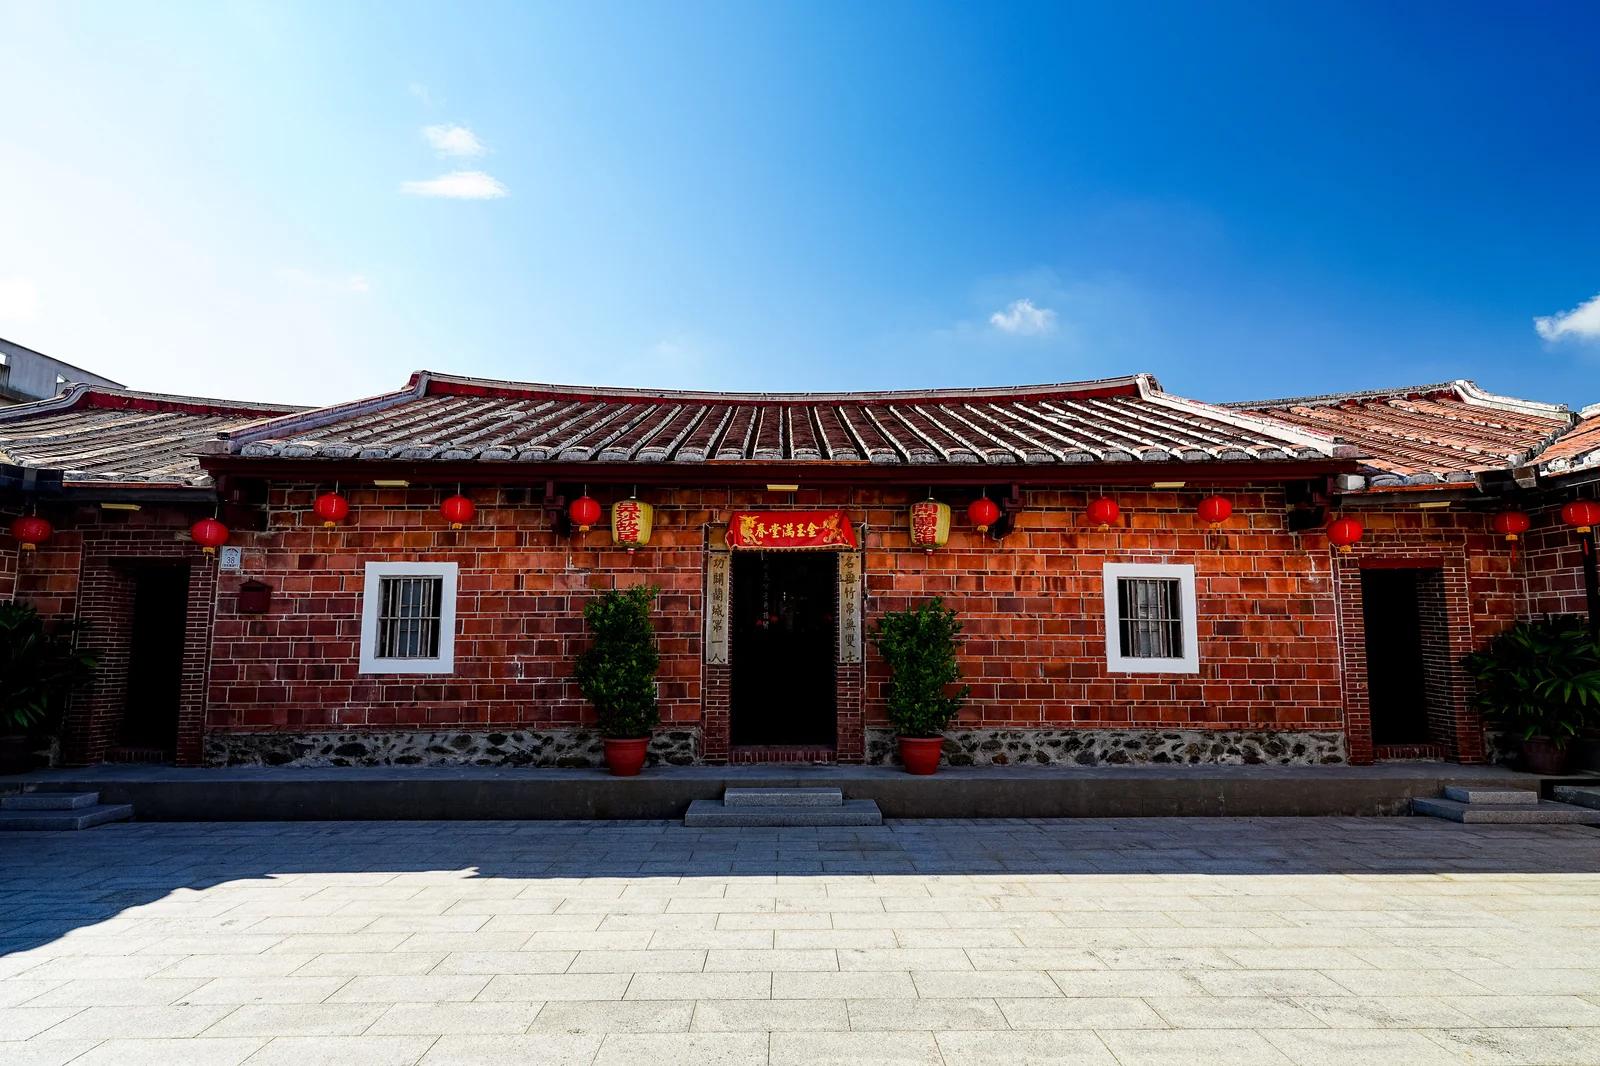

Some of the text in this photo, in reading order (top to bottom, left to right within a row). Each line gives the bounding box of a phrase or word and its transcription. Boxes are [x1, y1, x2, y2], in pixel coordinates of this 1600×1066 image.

[616, 502, 642, 542] 吳沙故居
[226, 556, 235, 564] 38
